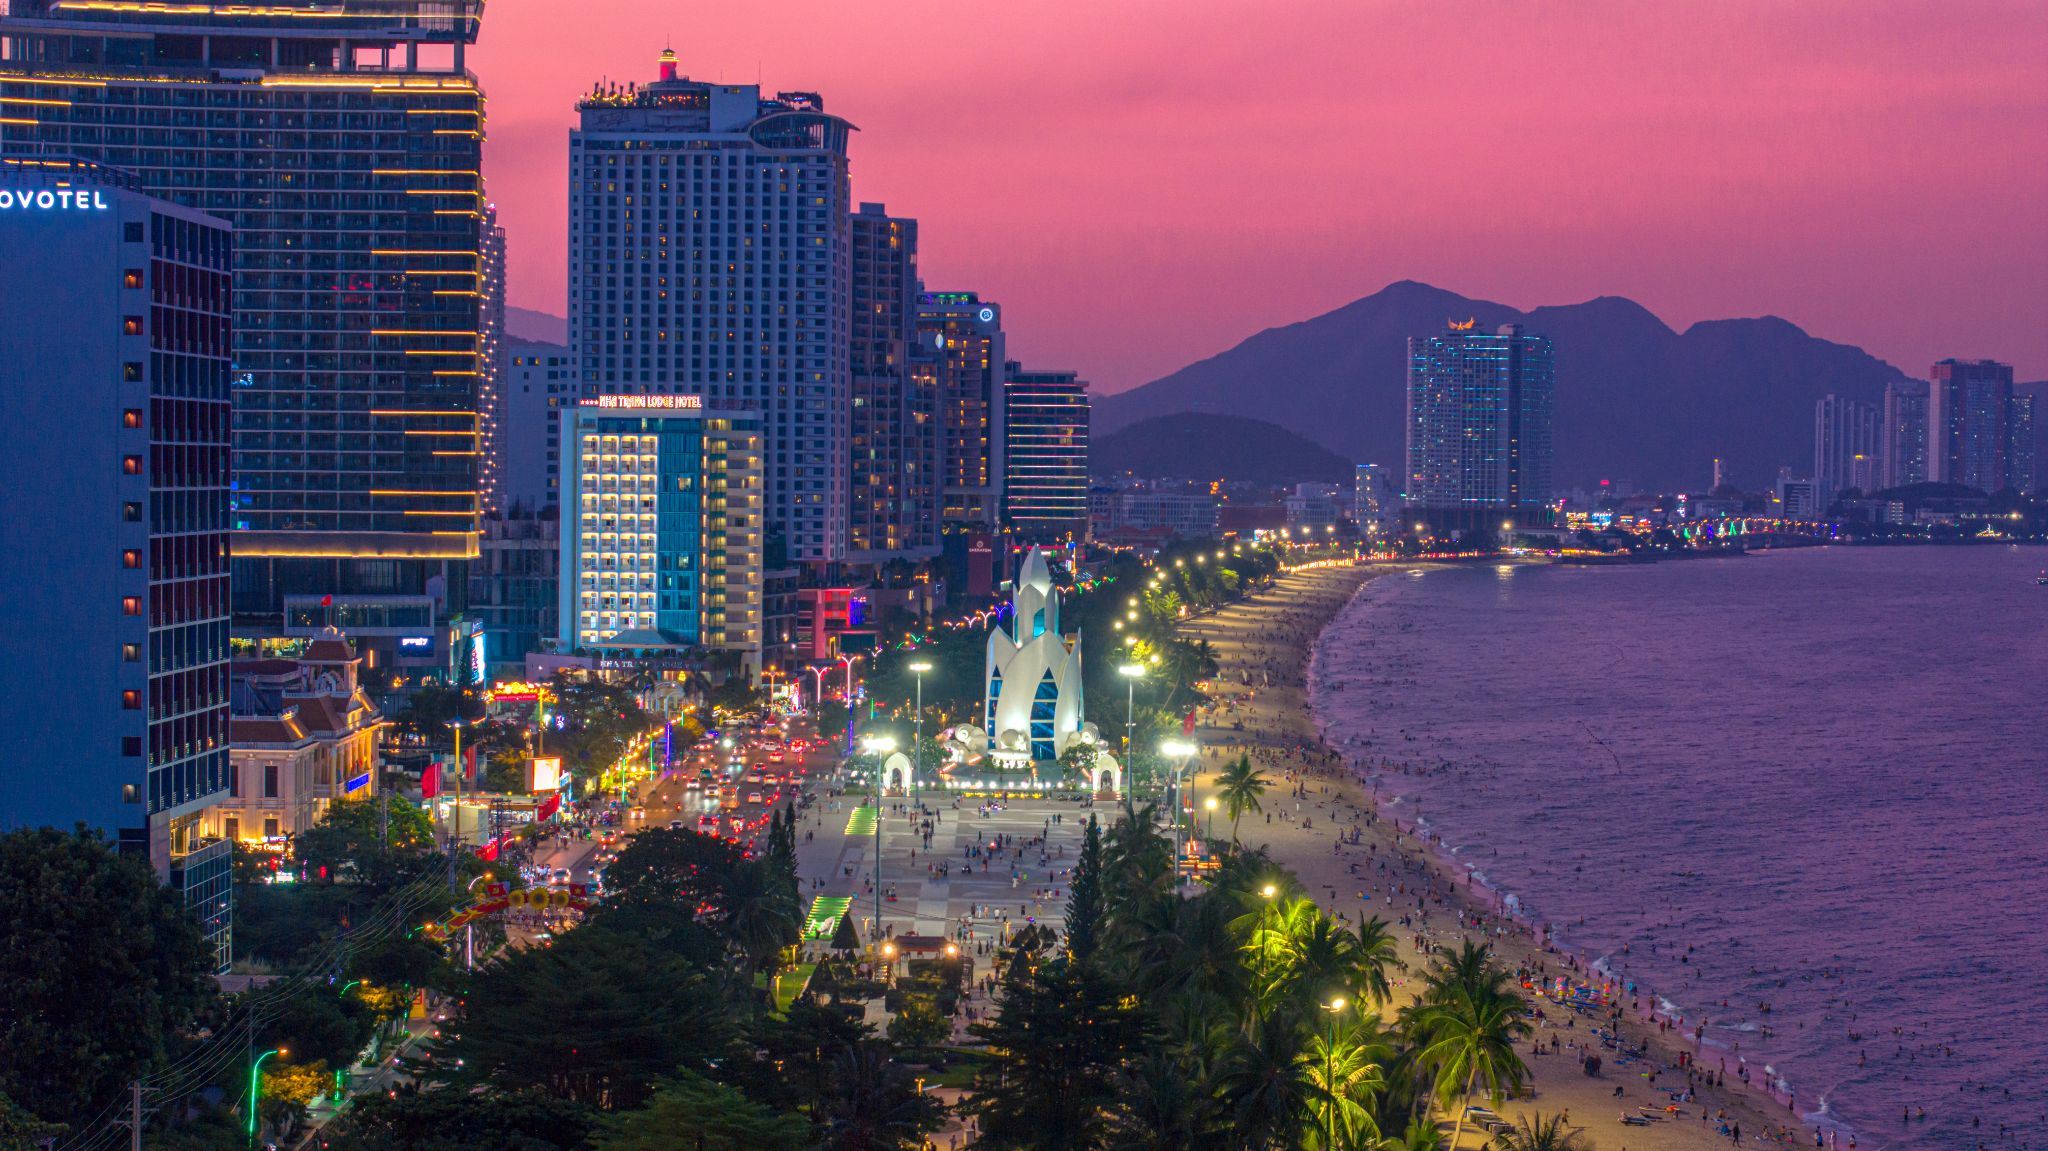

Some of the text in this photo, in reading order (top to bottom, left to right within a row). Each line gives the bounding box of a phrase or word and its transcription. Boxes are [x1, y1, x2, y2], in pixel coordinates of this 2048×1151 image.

[618, 395, 646, 409] TRANG
[647, 395, 674, 408] LODGE
[675, 395, 702, 409] HOTEL
